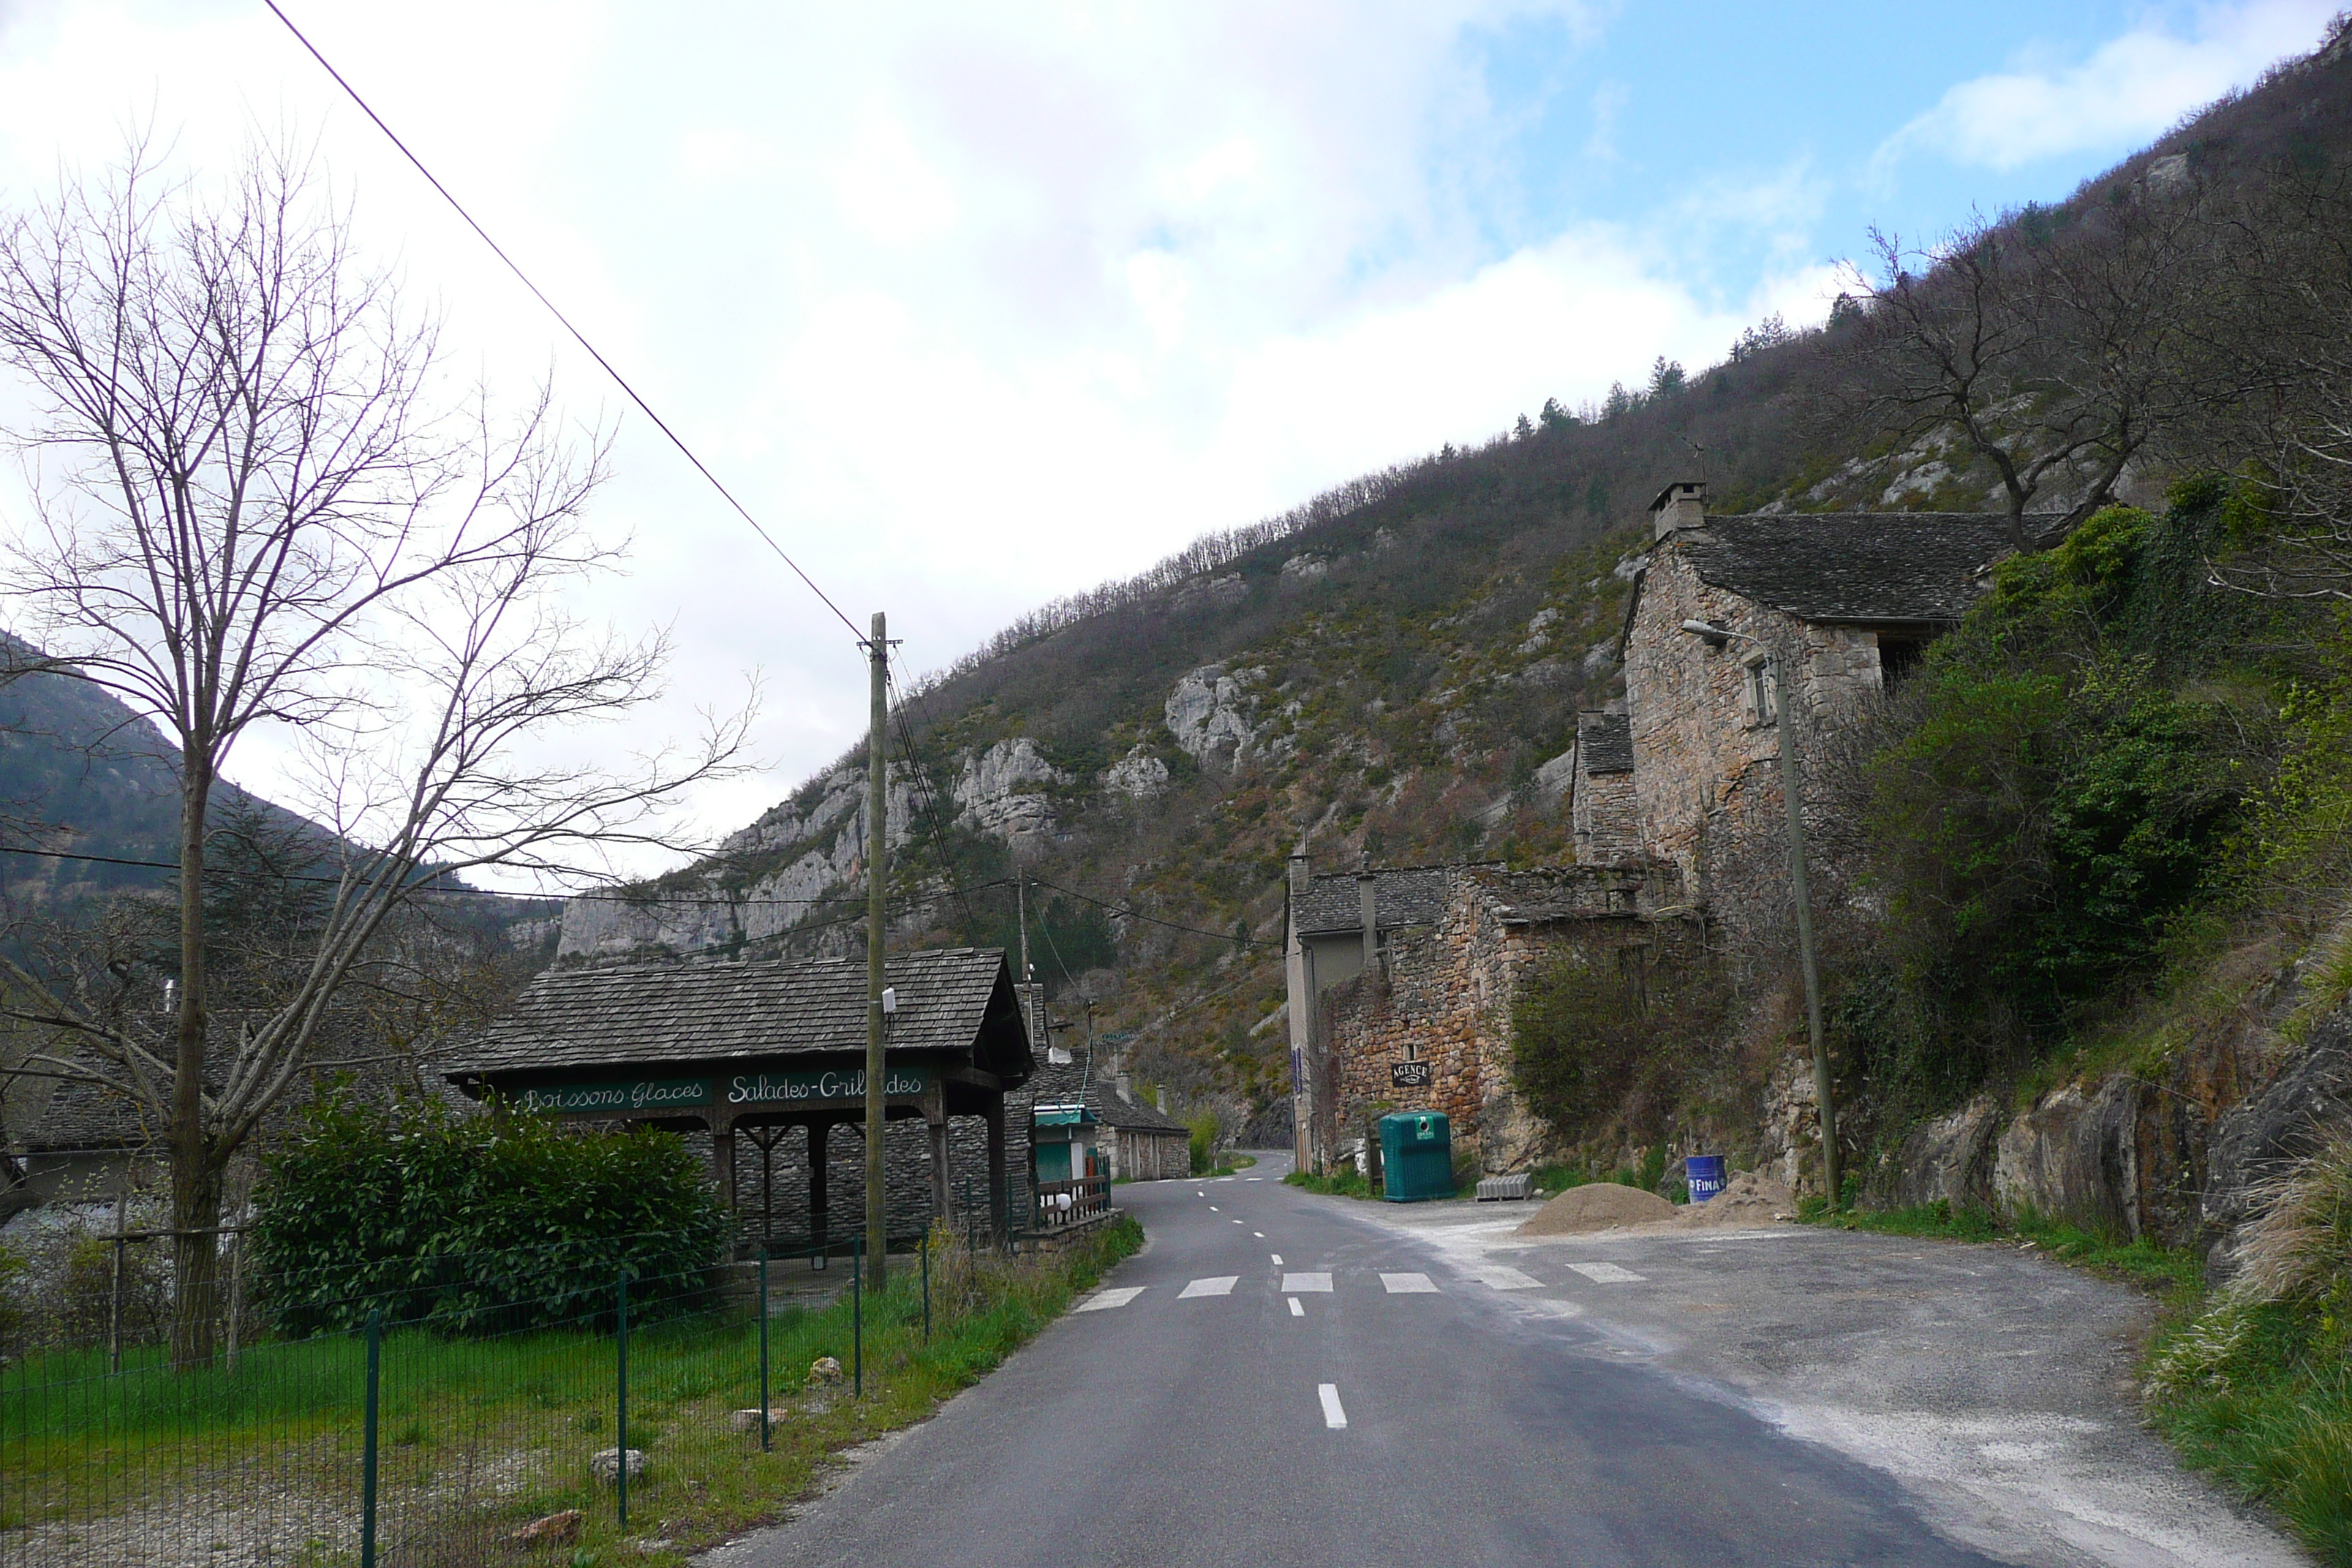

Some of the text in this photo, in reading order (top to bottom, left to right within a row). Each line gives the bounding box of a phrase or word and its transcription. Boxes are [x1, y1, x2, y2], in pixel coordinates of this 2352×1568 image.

[1393, 1064, 1428, 1079] AGENCE
[524, 1082, 703, 1109] Boissons Glaces
[728, 1069, 921, 1103] Salades-Grildes
[1696, 1179, 1720, 1191] FINA
